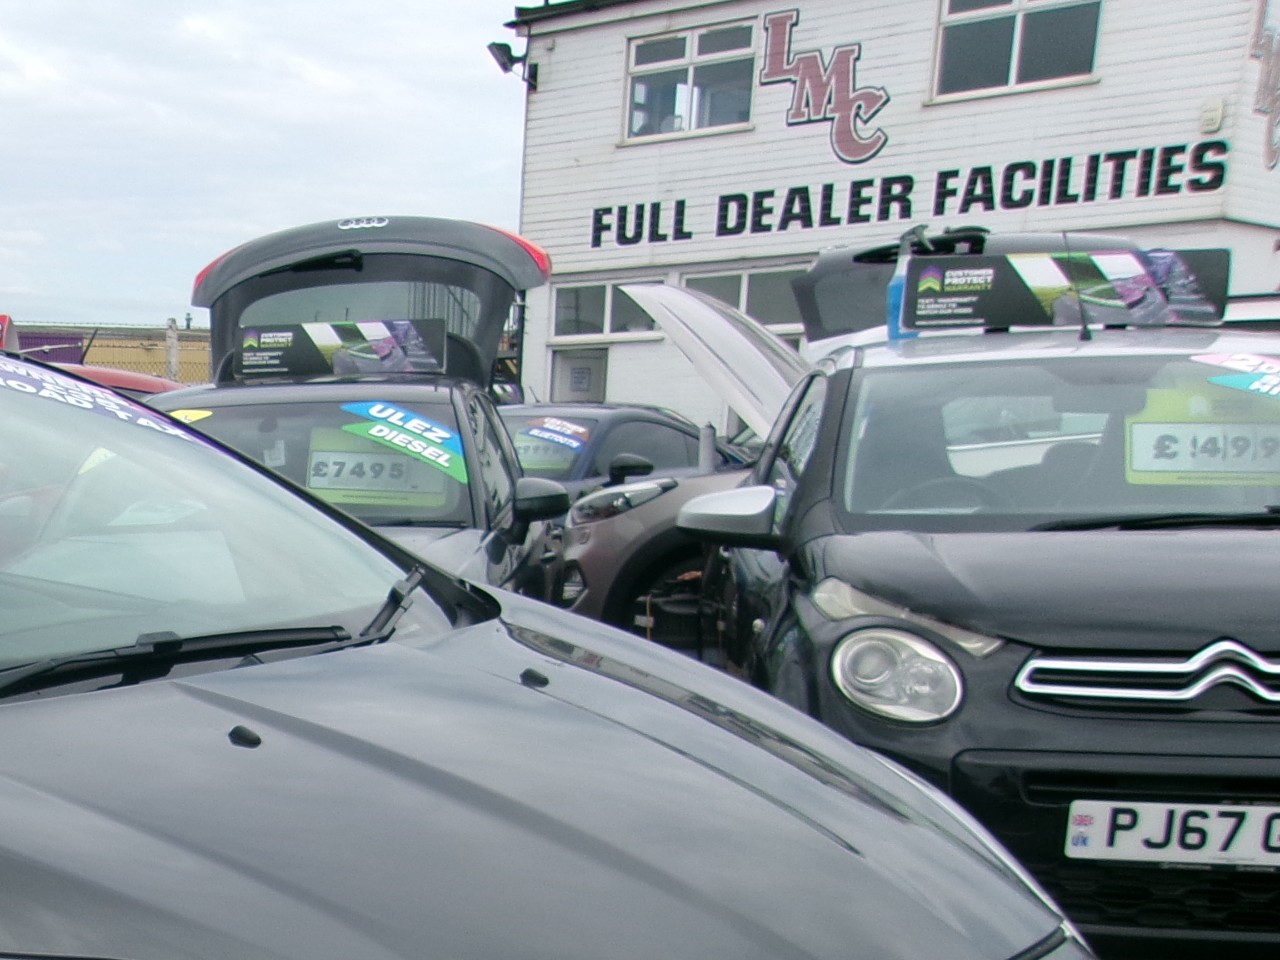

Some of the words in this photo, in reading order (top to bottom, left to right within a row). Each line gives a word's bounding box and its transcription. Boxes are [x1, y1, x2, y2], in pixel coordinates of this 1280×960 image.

[760, 6, 890, 164] LMC
[590, 200, 692, 249] FULL
[715, 175, 914, 238] DEALER
[932, 141, 1229, 217] FACILITIES
[105, 406, 195, 442] TAX
[368, 403, 452, 444] ULEZ
[368, 424, 451, 467] DIESEL
[311, 461, 406, 480] £7495
[1106, 806, 1248, 852] PJ67
